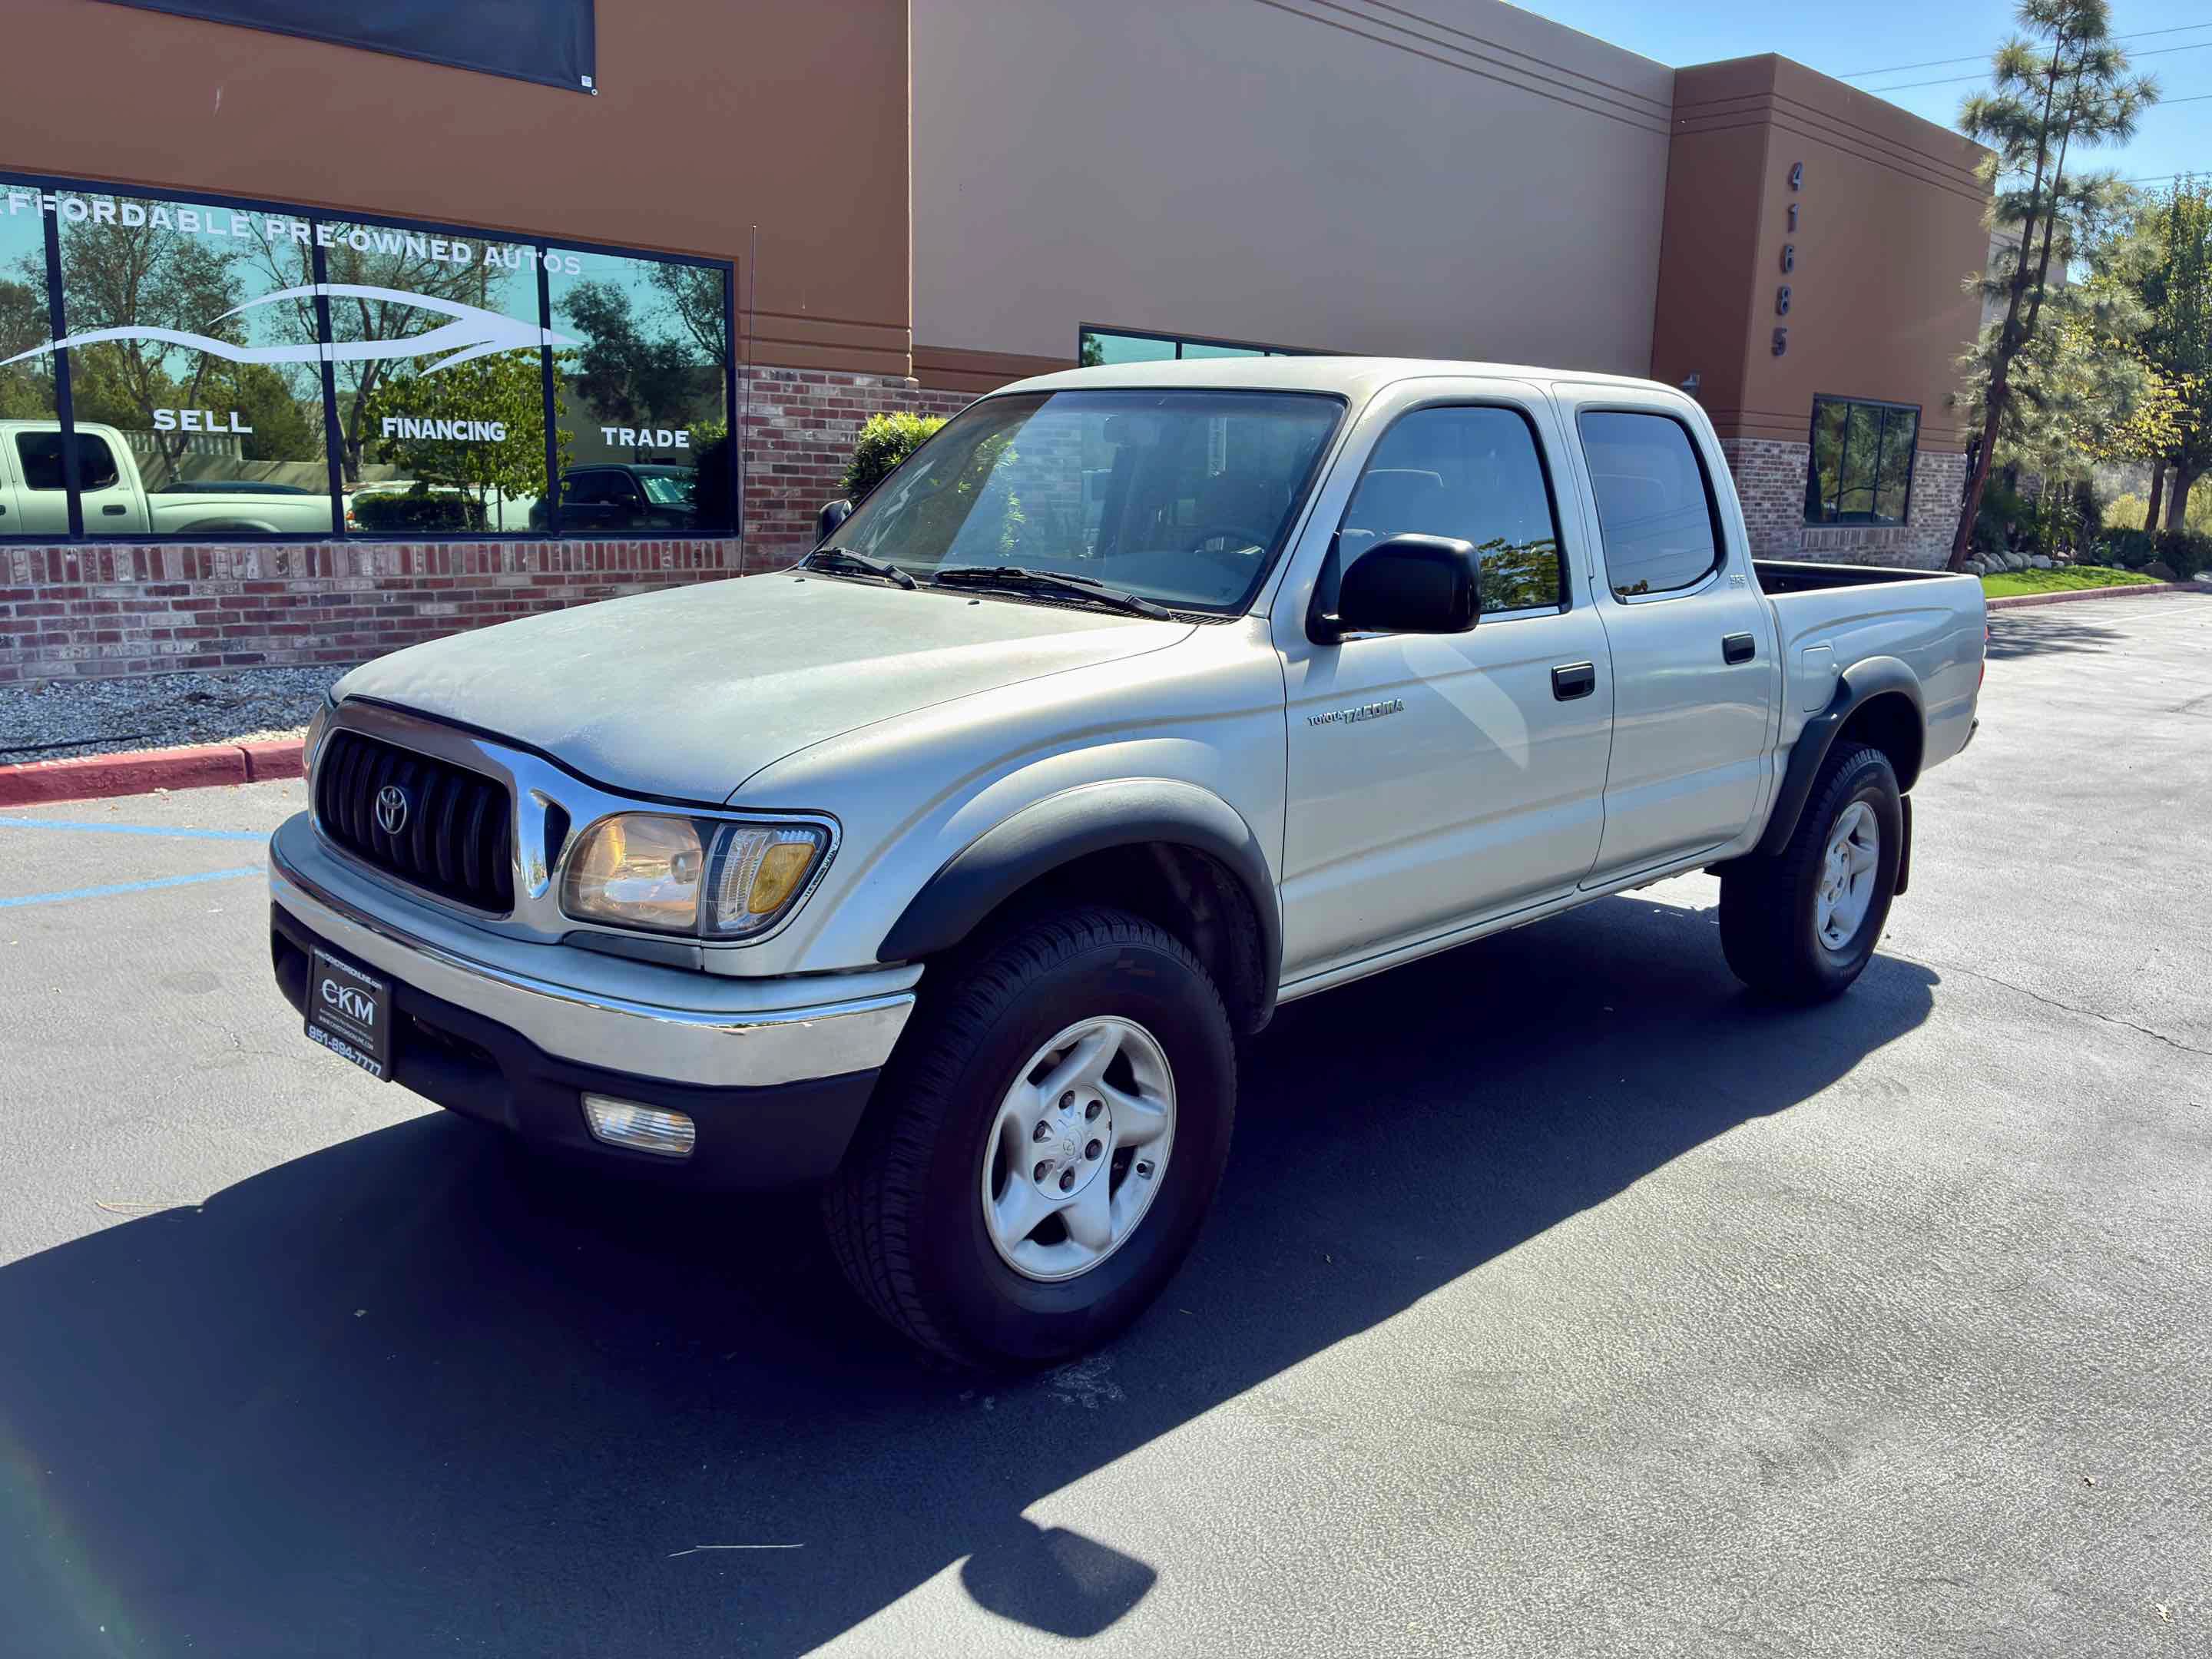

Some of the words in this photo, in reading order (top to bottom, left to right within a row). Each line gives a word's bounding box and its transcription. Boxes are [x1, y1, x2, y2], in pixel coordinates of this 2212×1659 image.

[0, 192, 250, 237] FFORDABLE
[266, 219, 472, 265] PRE-OWNED
[483, 246, 581, 275] AUTOS
[1771, 161, 1803, 357] 41685
[153, 408, 253, 434] SELL
[381, 416, 507, 442] FINANCING
[601, 426, 690, 449] TRADE
[1308, 710, 1344, 726] TOYOTA
[1344, 698, 1405, 724] TACOMA
[322, 978, 374, 1026] CKM
